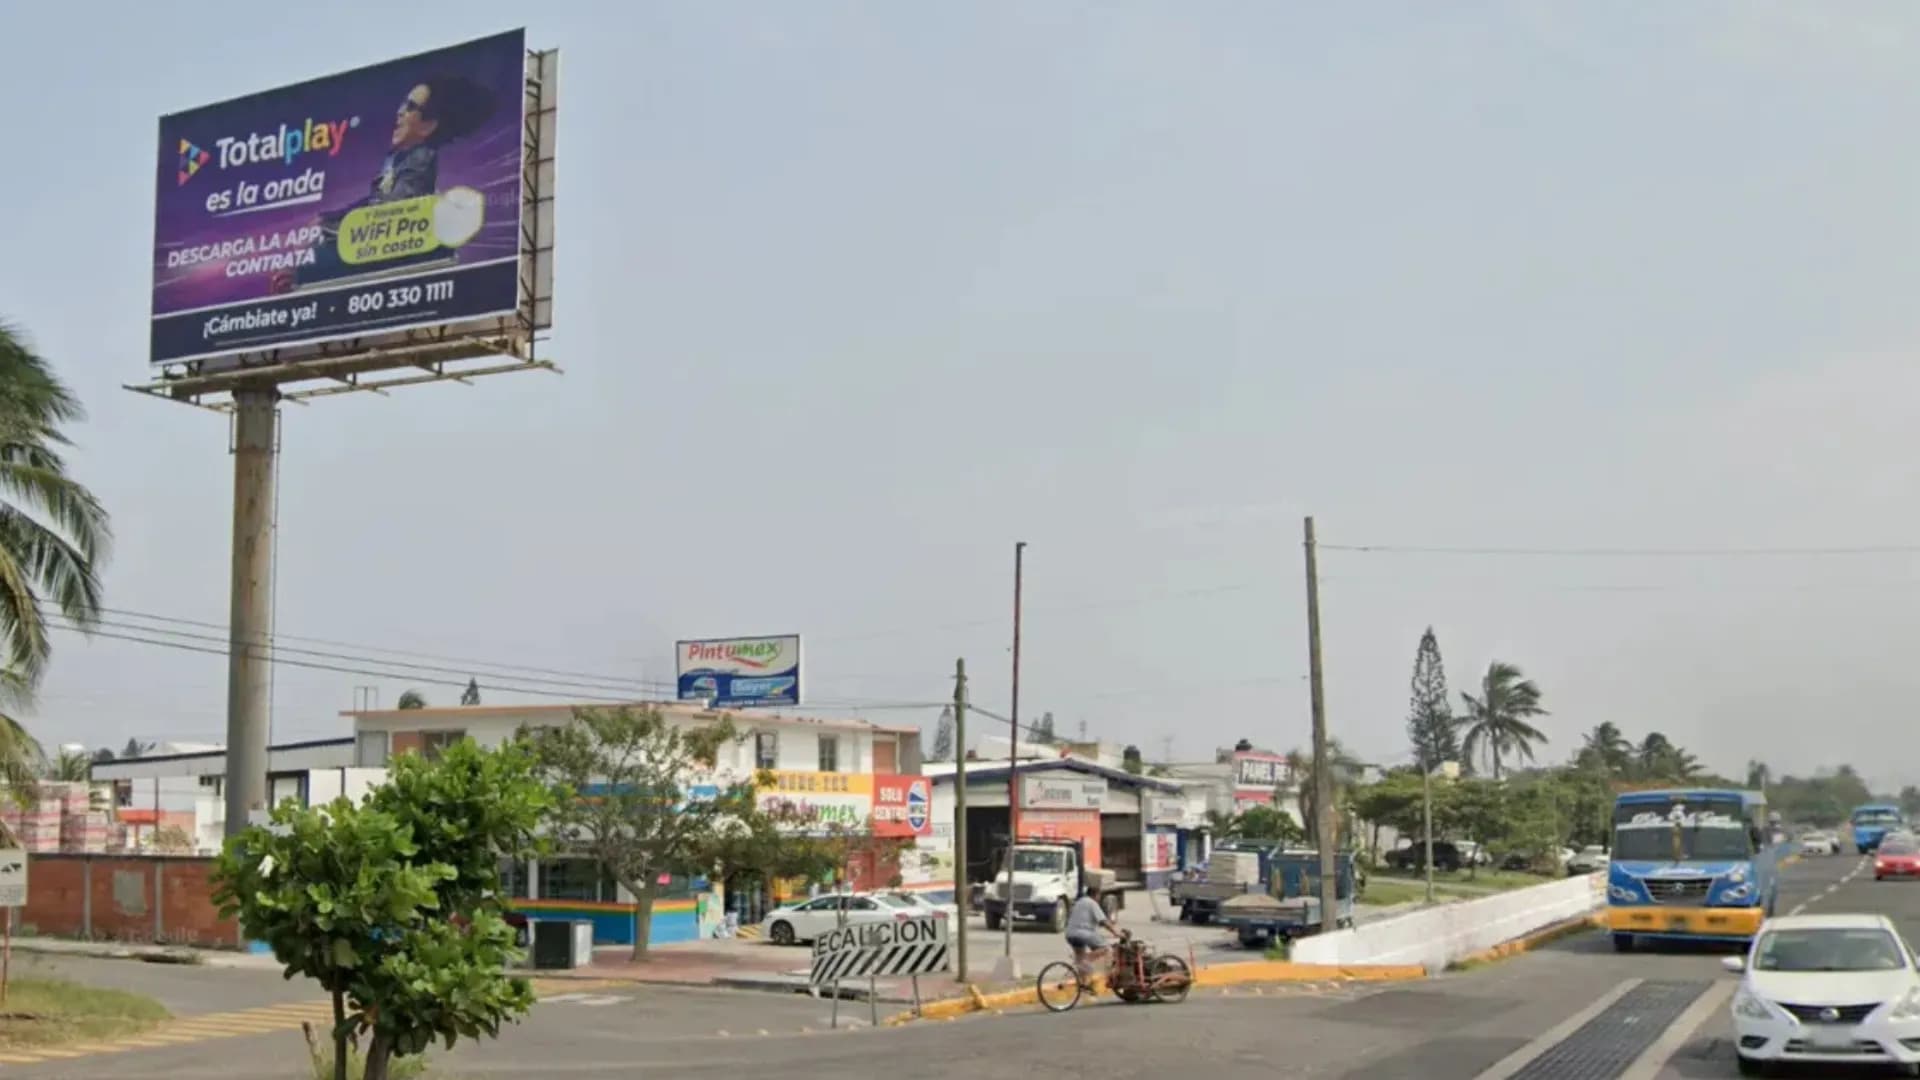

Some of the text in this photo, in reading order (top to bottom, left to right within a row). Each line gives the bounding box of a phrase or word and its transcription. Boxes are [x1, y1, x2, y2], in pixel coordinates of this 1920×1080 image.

[216, 117, 348, 169] Totalplay
[206, 168, 325, 212] es la onda
[167, 225, 324, 268] DESCARGA LA APP,
[350, 217, 429, 244] WiFi Pro
[356, 236, 424, 259] sin costo
[225, 248, 316, 277] CONTRATA
[348, 280, 454, 314] 800 330 1111
[203, 307, 288, 339] ¡Cámbiate
[291, 301, 318, 328] ya!
[812, 919, 937, 957] ECAUCION
